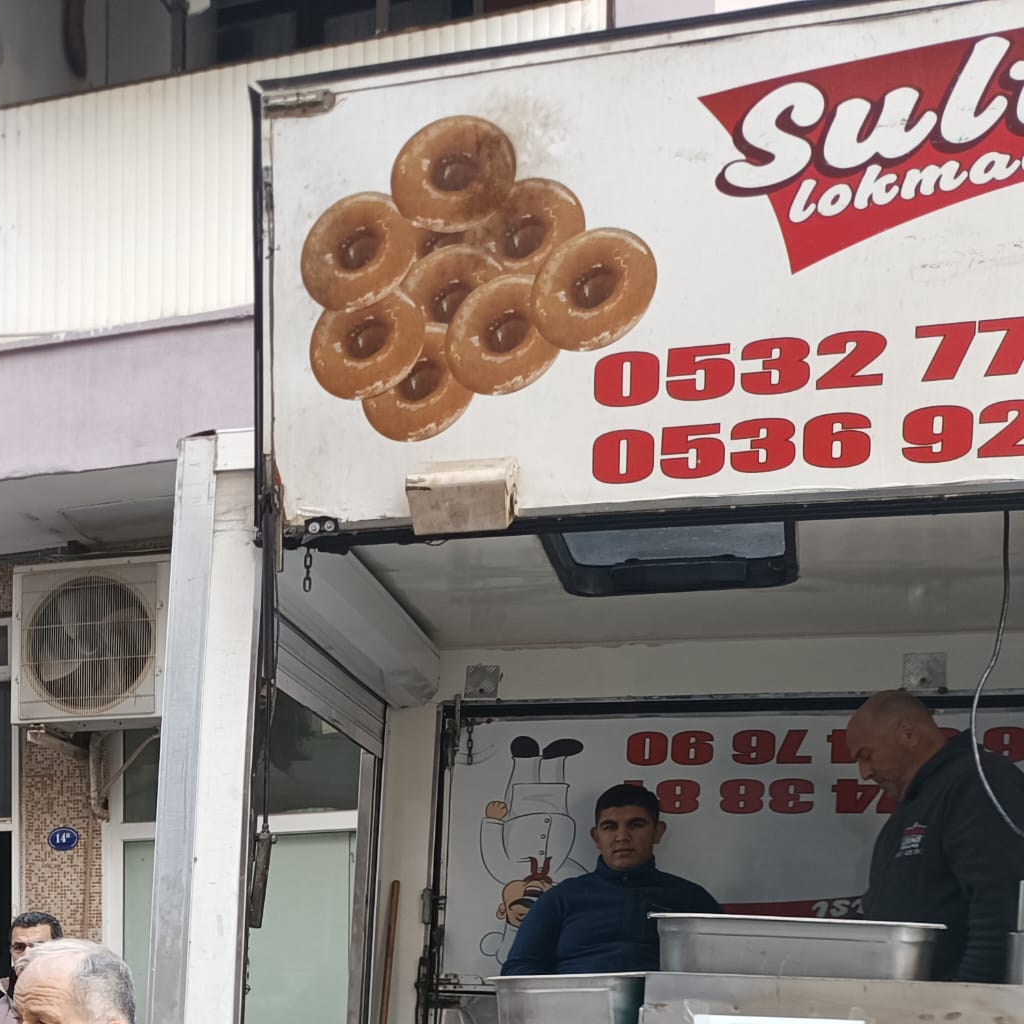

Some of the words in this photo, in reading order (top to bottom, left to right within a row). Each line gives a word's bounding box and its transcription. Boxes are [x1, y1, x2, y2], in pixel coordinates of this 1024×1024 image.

[788, 151, 1024, 224] lokma
[594, 330, 887, 407] 0532
[915, 317, 1024, 382] 77
[592, 412, 871, 484] 0536
[902, 399, 1024, 464] 92
[626, 730, 714, 766] 90
[732, 729, 812, 765] 76
[719, 778, 815, 814] 38
